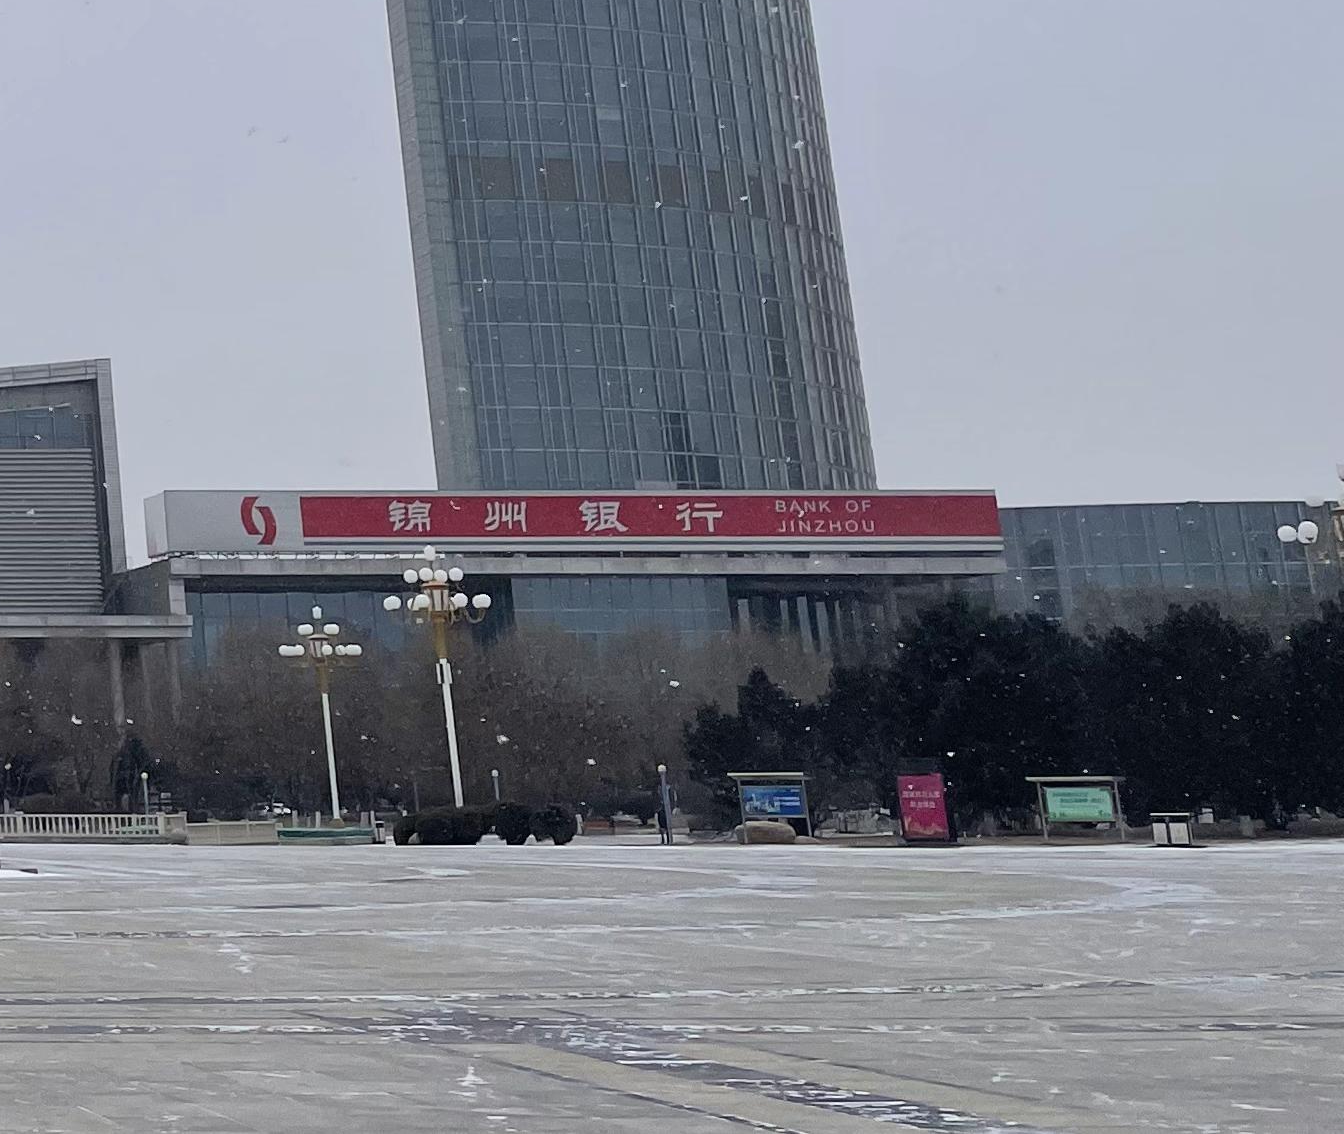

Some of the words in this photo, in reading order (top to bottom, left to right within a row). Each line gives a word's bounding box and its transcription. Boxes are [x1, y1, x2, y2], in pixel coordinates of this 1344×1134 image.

[775, 499, 832, 513] BANK
[845, 499, 871, 513] OF
[388, 499, 723, 533] 锦州银行
[778, 519, 875, 533] JINZHOU
